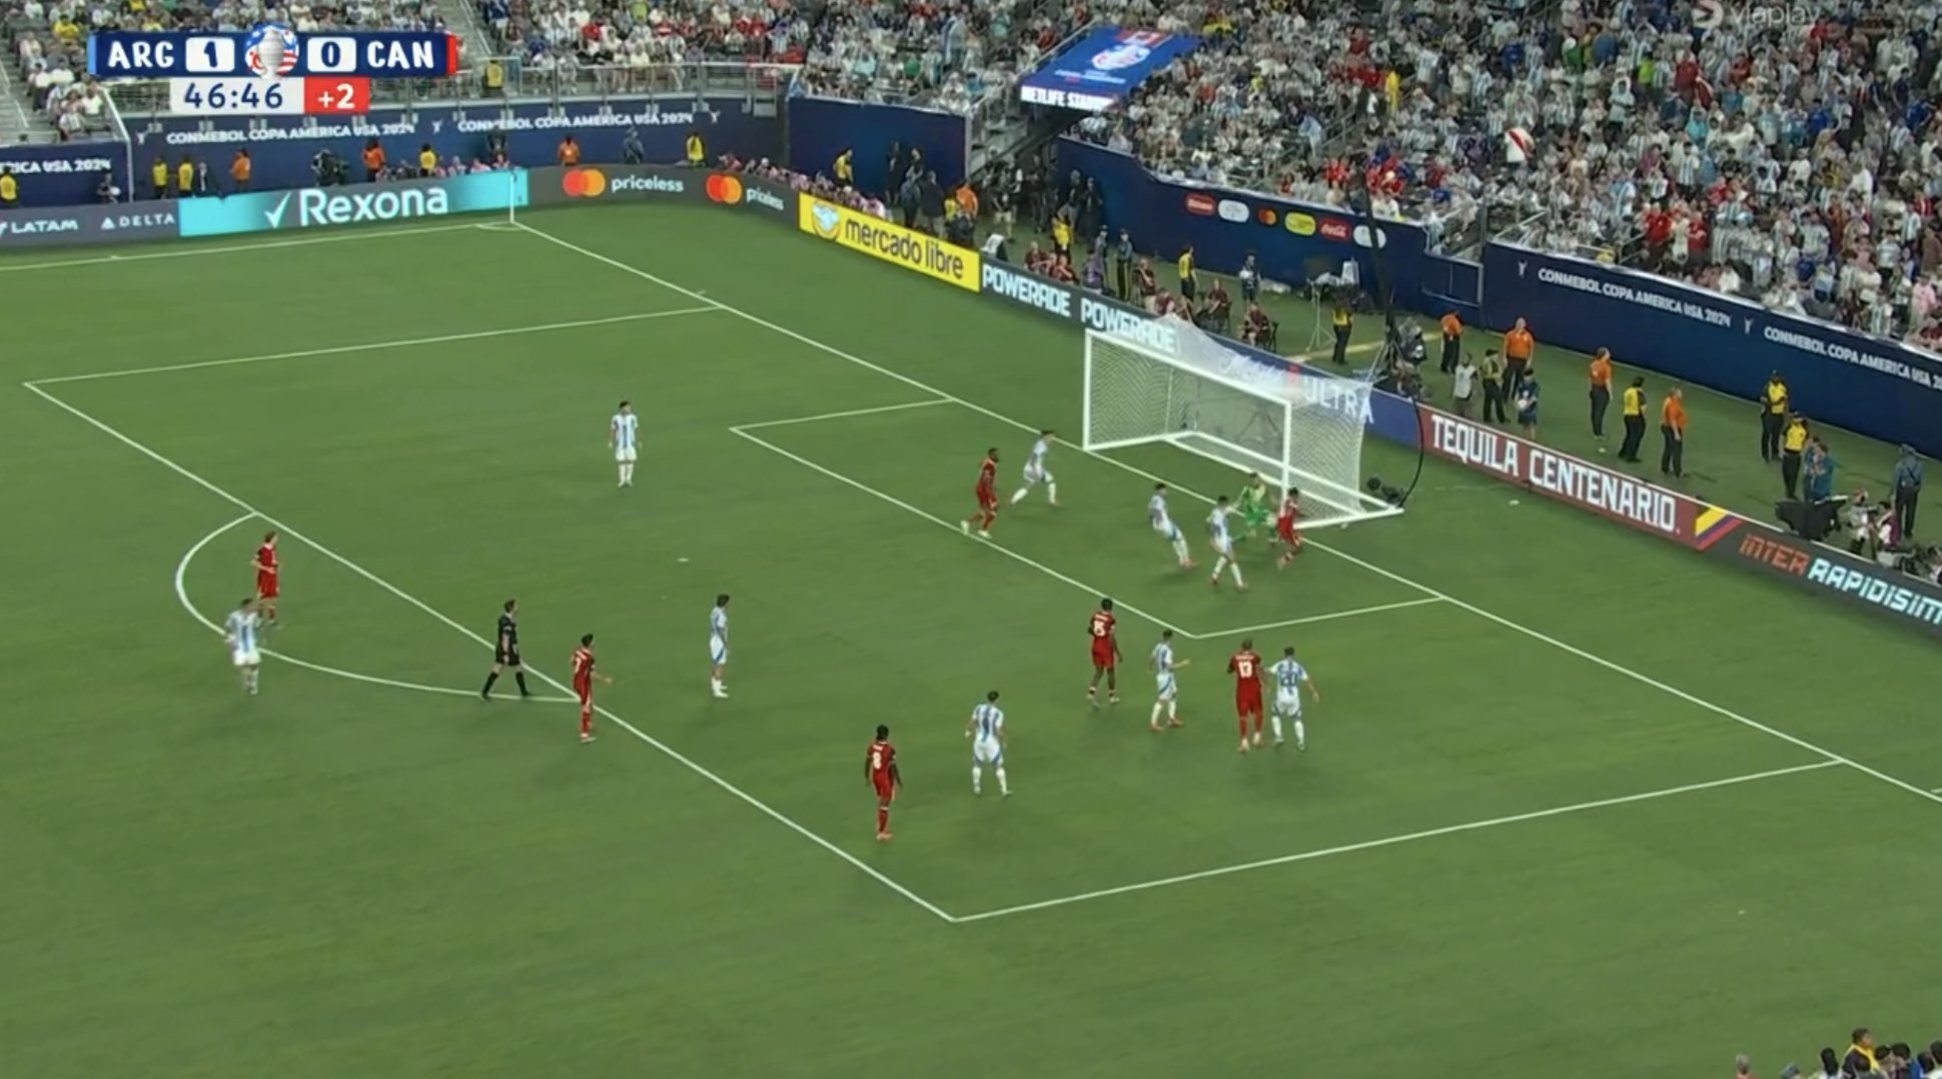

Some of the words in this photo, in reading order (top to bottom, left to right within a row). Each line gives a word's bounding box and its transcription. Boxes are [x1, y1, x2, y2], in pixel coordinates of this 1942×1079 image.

[166, 130, 246, 144] CONMEBOL
[249, 127, 287, 141] COPA
[288, 124, 350, 139] AMERICA
[353, 123, 380, 137] USA
[457, 117, 533, 132] CONMEBOL
[572, 114, 632, 127] AMERICA
[634, 113, 660, 125] USA
[42, 160, 73, 173] USA
[74, 158, 111, 171] 2024
[611, 173, 684, 193] priceless
[11, 218, 79, 234] LATAM
[119, 213, 175, 228] DELTA
[299, 185, 449, 226] Rexona
[845, 218, 923, 264] mercado
[925, 239, 965, 280] libre
[982, 263, 1071, 318] POWERADE
[1538, 267, 1602, 294] CONMEBOL
[1602, 282, 1635, 303] COPA
[1635, 291, 1683, 315] AMERICA
[1080, 297, 1177, 354] POWERADE
[1764, 326, 1827, 356] CONMEBOL
[1828, 344, 1859, 365] COPA
[1860, 355, 1910, 380] AMERICA
[1431, 414, 1519, 477] TEQUILA
[1739, 533, 1810, 577] INTER
[872, 751, 882, 769] 8
